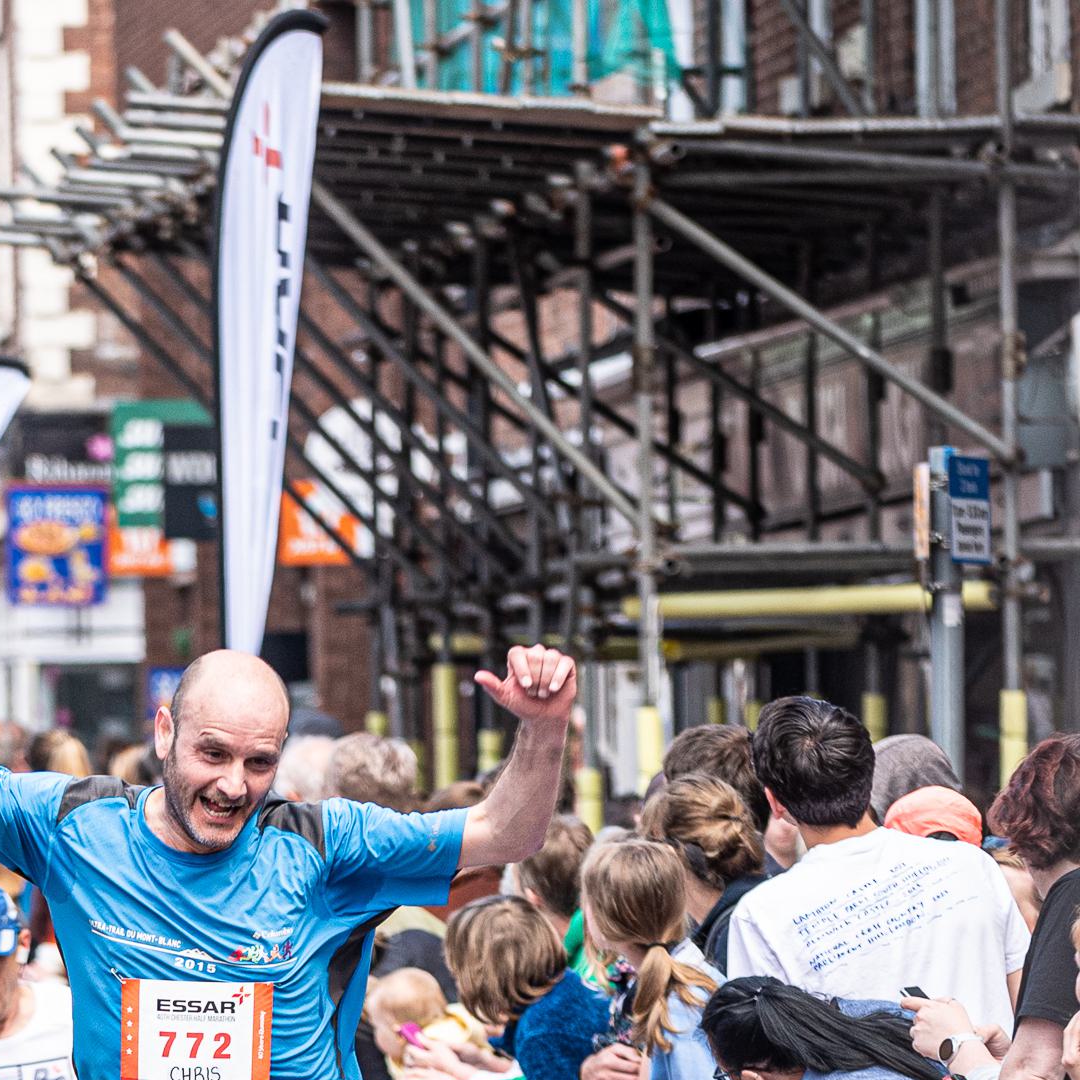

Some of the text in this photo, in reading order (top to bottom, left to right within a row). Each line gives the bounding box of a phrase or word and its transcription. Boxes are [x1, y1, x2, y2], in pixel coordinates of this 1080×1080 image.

[126, 929, 136, 939] DU
[174, 956, 217, 974] 2015
[157, 999, 236, 1014] ESSAR
[207, 1015, 236, 1023] MARATHON
[159, 1031, 232, 1059] 772
